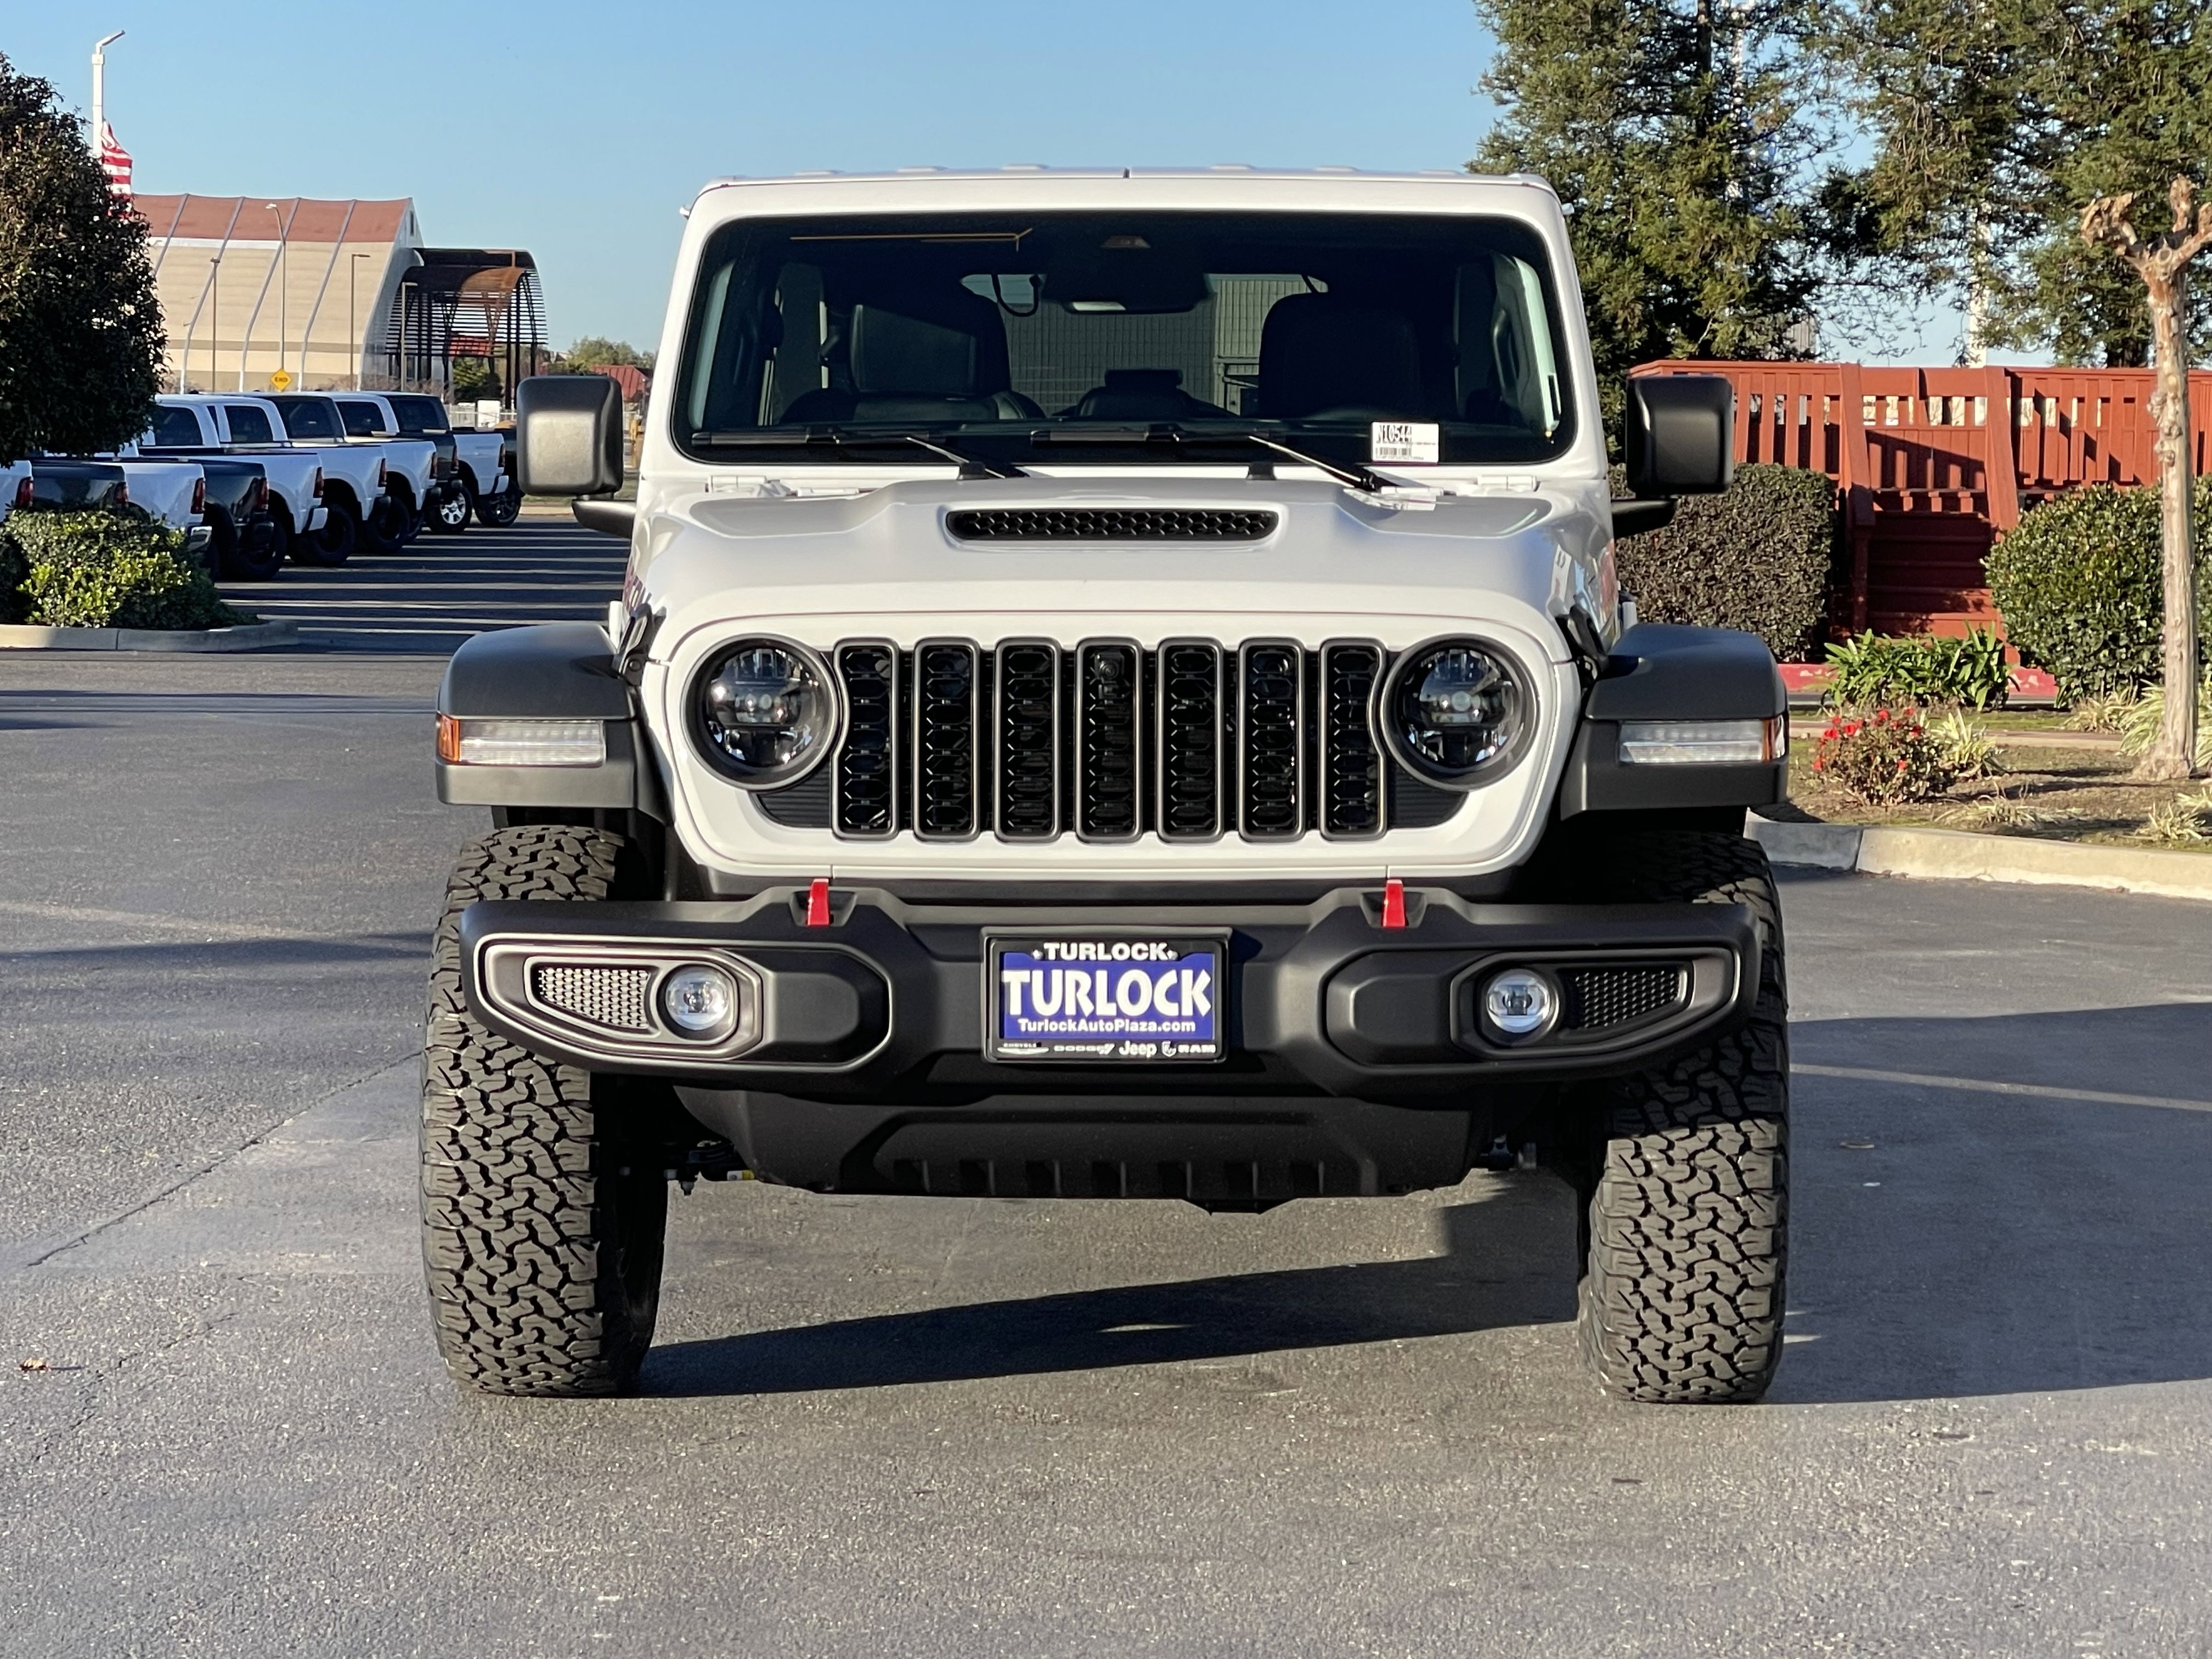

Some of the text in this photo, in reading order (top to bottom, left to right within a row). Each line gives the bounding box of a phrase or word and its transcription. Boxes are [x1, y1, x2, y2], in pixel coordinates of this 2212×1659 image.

[1043, 942, 1168, 961] TURLOCK
[1002, 969, 1211, 1017] TURLOCK
[1018, 1018, 1196, 1032] TurlockAutoPlaza.com
[1118, 1040, 1157, 1058] Jeep
[1178, 1044, 1216, 1053] RAM
